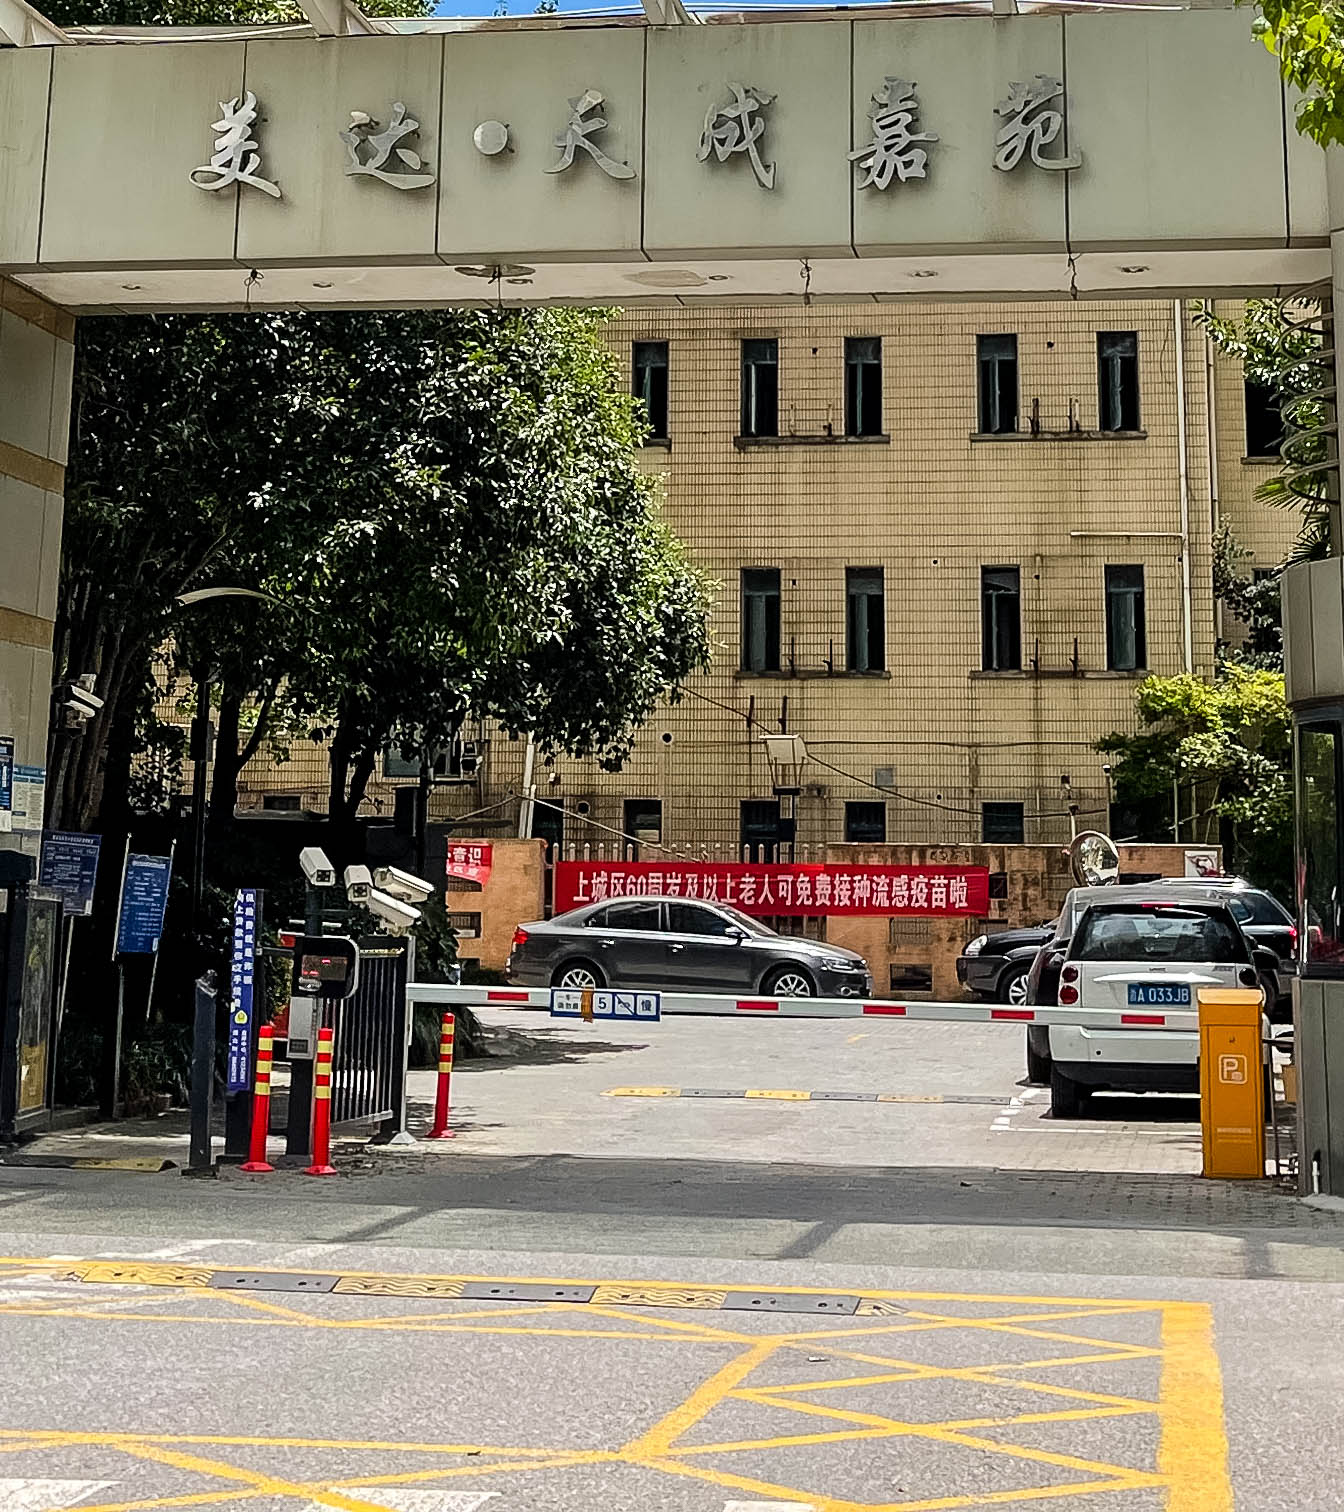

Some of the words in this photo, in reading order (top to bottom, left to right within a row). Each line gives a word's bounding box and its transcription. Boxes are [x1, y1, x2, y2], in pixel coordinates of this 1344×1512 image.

[572, 870, 969, 909] 上城区60周岁及以上老人可免费接种流感疫苗啦
[598, 997, 606, 1009] 5
[1223, 1058, 1238, 1079] P
